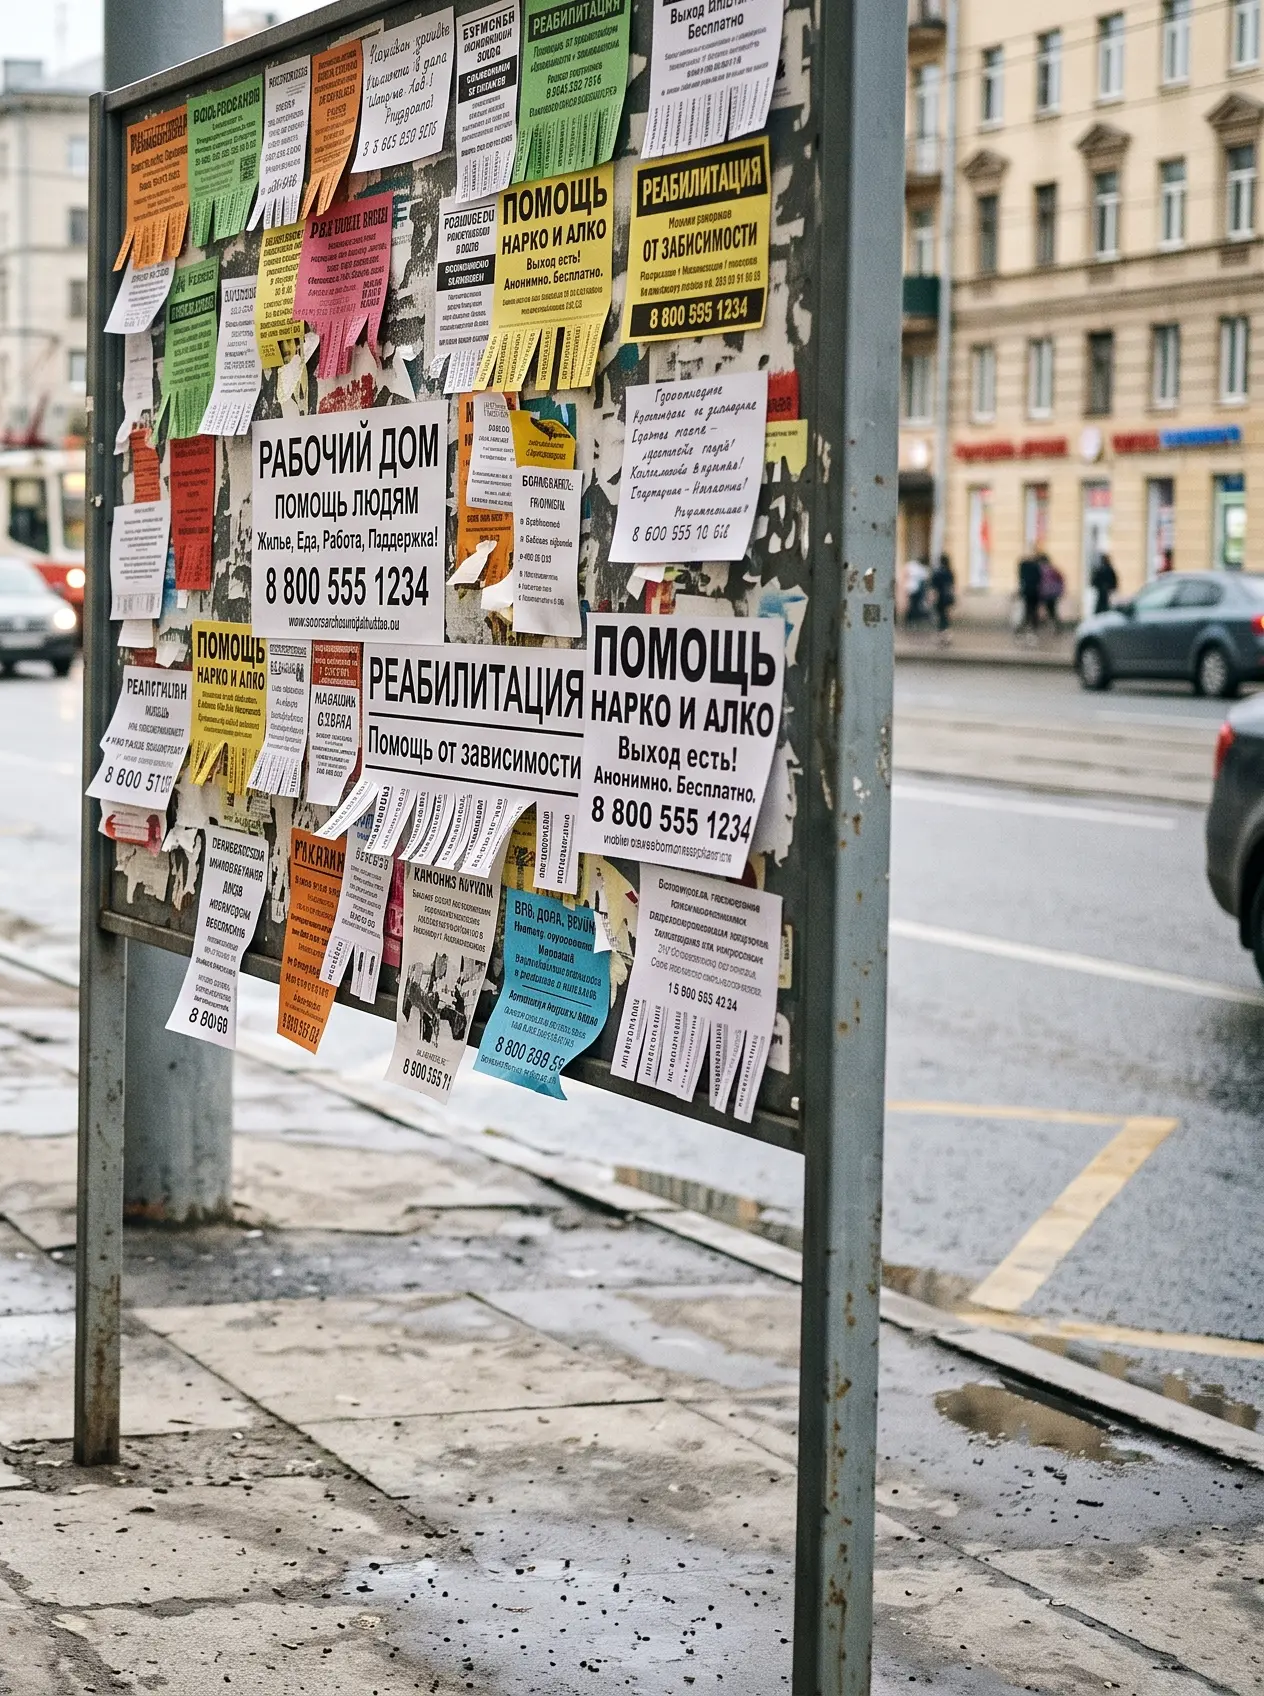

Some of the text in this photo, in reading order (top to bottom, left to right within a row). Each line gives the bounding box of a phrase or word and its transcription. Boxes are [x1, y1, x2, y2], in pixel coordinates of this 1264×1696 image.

[670, 4, 704, 24] Выход
[642, 155, 762, 207] РЕАБИЛИТАЦИЯ
[503, 175, 608, 226] ПОМОЩЬ
[502, 218, 607, 256] НАРКО И АЛКО
[643, 238, 659, 263] ОТ
[504, 266, 604, 291] Анонимно. Бесплатно.
[526, 249, 581, 272] Выход есть!
[649, 307, 658, 329] 8
[661, 304, 685, 328] 800
[716, 296, 748, 321] 1234
[259, 419, 372, 479] РАБОЧИЙ
[378, 422, 439, 480] ДОМ
[274, 486, 419, 523] ПОМОЩЬ ЛЮДЯМ
[297, 530, 320, 553] Еда,
[323, 529, 365, 553] Работа,
[632, 526, 640, 542] 8
[265, 565, 429, 607] 8 800 555 1234
[197, 630, 266, 670] ПОМОЩЬ
[593, 624, 777, 697] ПОМОЩЬ
[197, 666, 228, 686] НАРКО
[369, 656, 584, 725] РЕАБИЛИТАЦИЯ
[591, 689, 775, 739] НАРКО И АЛКО
[368, 725, 434, 766] Помощь
[438, 740, 457, 764] от
[460, 743, 582, 780] зависимости
[618, 735, 738, 772] Выход есть!
[104, 765, 114, 784] 8
[593, 765, 757, 804] Анонимно. Бесплатно.
[591, 795, 753, 844] 8 800 555 1234
[188, 1007, 200, 1024] 8
[494, 1035, 504, 1053] 8
[504, 1039, 527, 1061] 800
